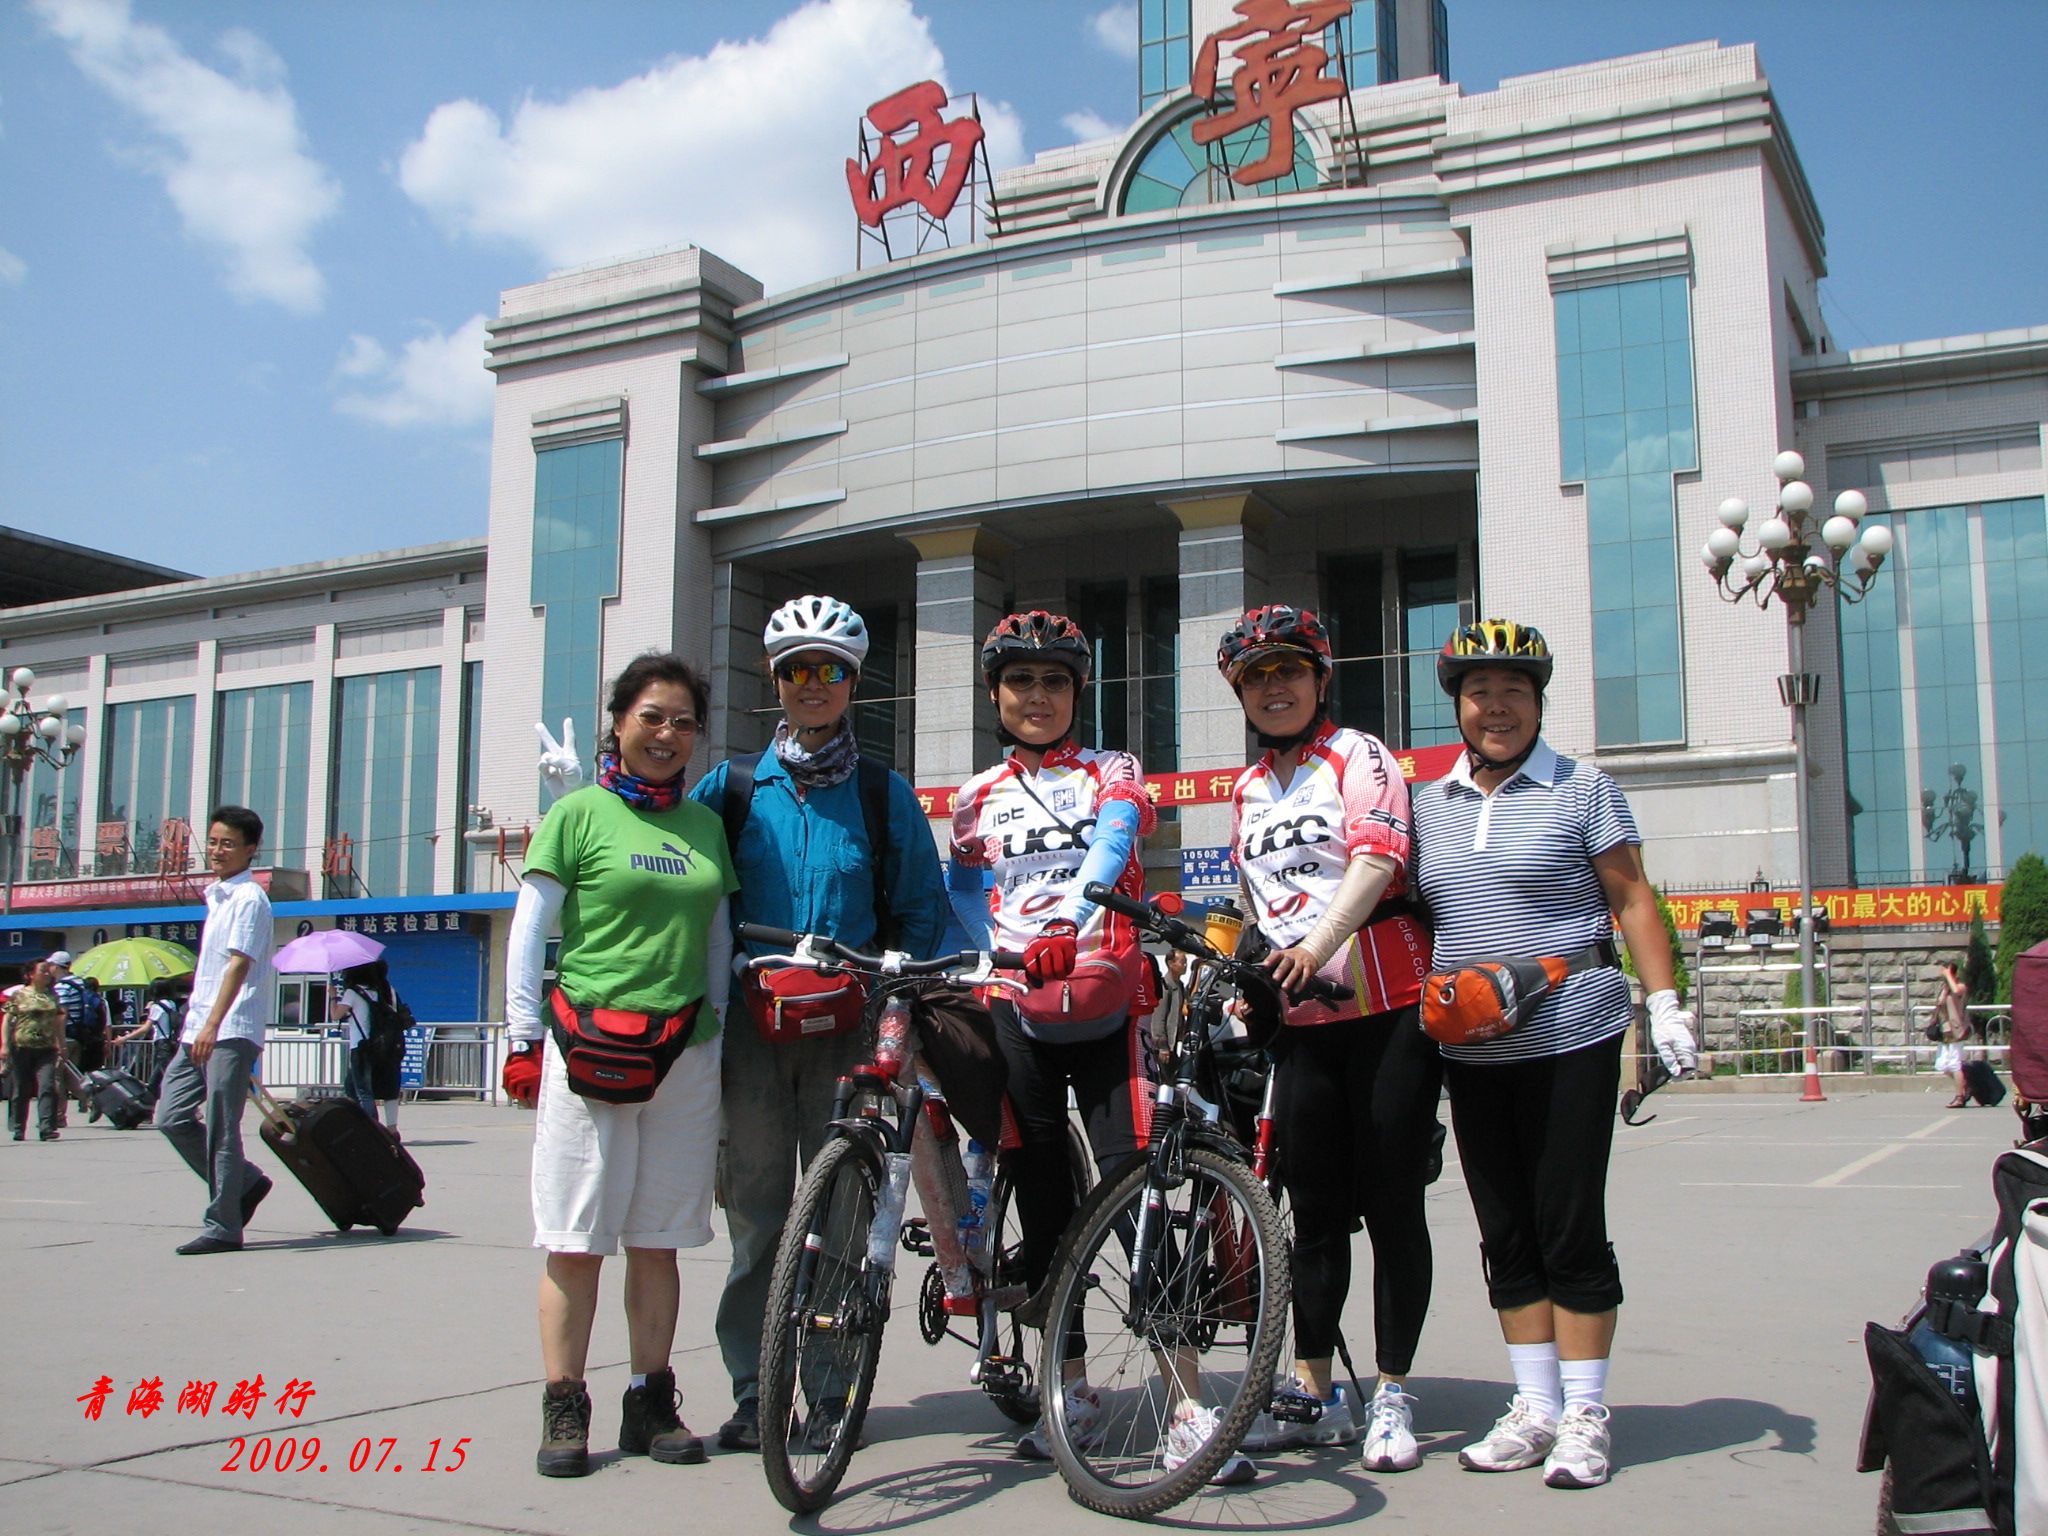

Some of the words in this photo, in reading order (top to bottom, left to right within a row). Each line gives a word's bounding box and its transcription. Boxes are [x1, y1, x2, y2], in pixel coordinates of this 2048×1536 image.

[630, 853, 687, 876] PUMA
[1182, 849, 1220, 860] 1050次
[343, 911, 461, 934] 进站安检通道
